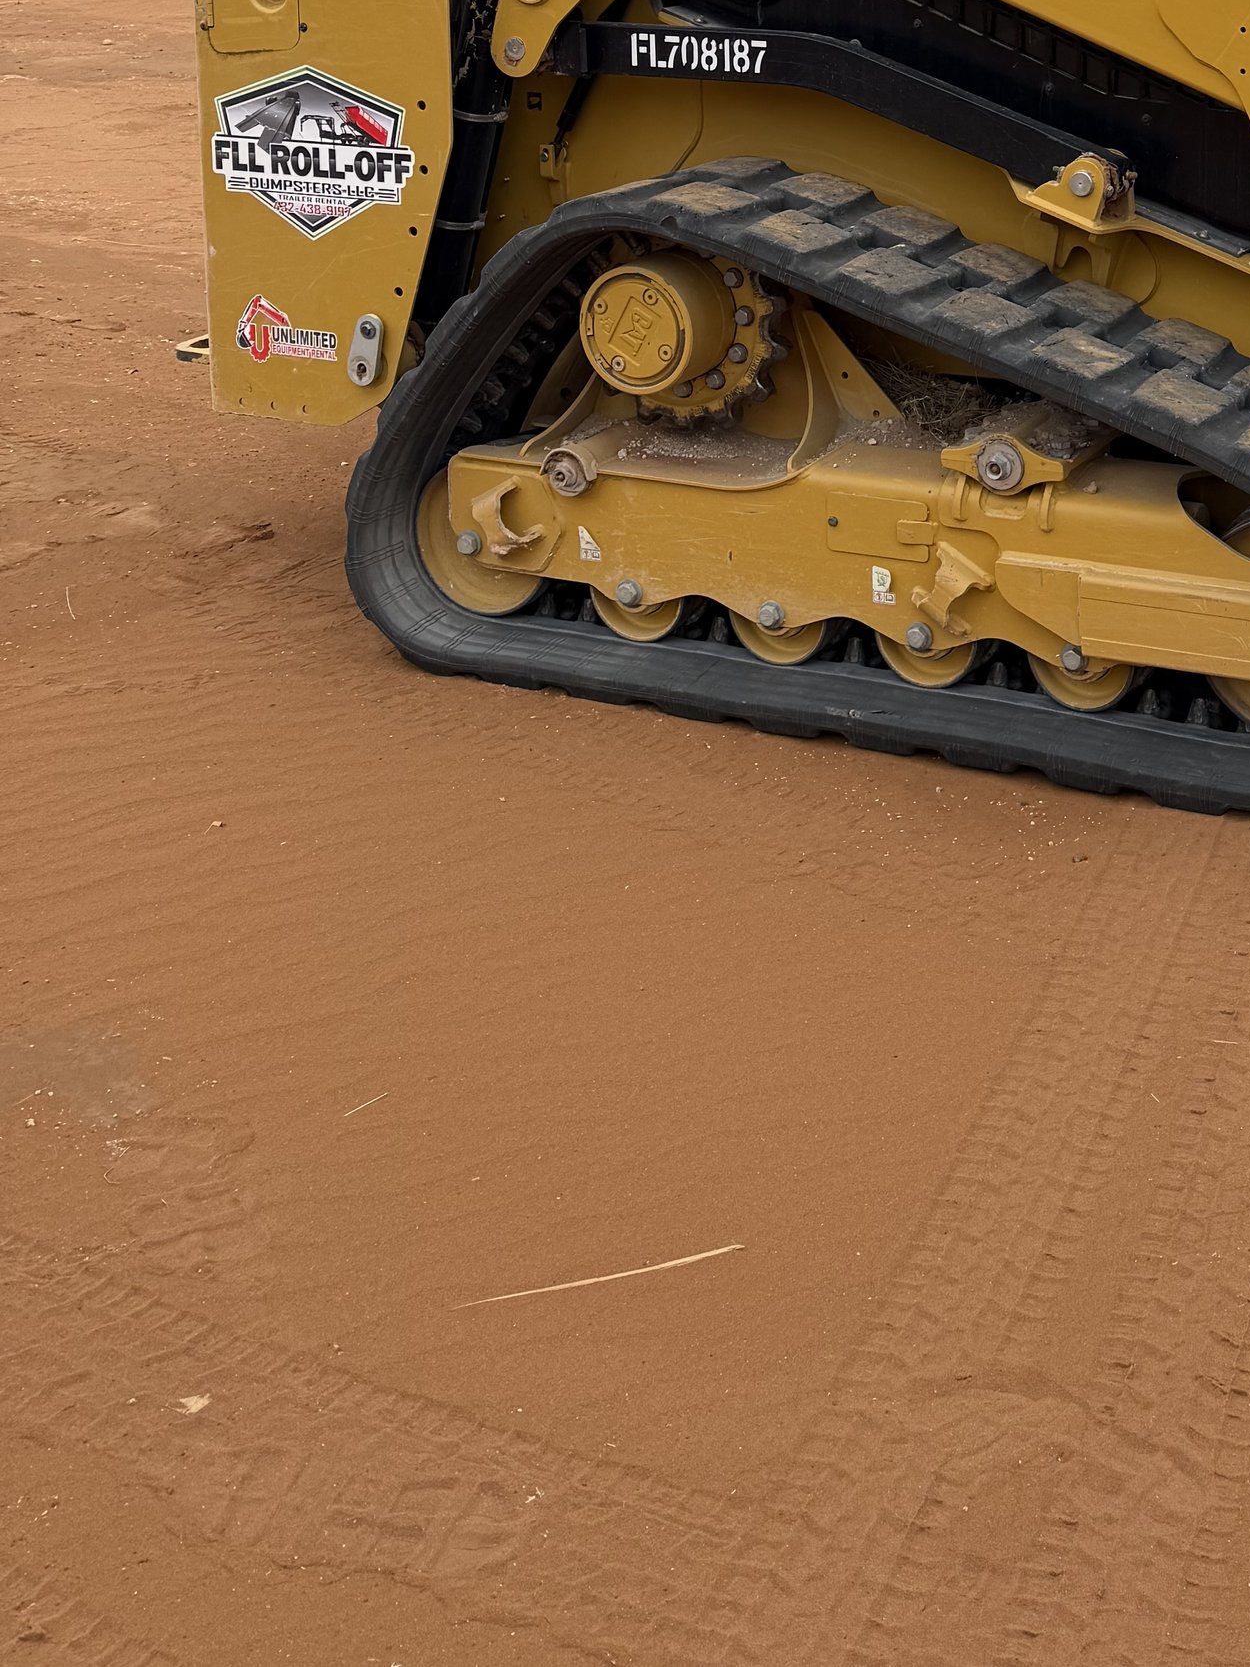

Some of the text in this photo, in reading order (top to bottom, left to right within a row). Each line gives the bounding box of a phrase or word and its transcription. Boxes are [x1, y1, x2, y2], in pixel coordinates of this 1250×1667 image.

[631, 33, 767, 74] FL708187
[215, 140, 412, 184] FLL ROLL-OFF
[249, 177, 375, 198] DUMPSTERS LLC
[279, 194, 347, 206] TRAILER RENTAL
[272, 326, 336, 349] UNLIMITED
[272, 344, 336, 360] EQUIPMENT RENTAL
